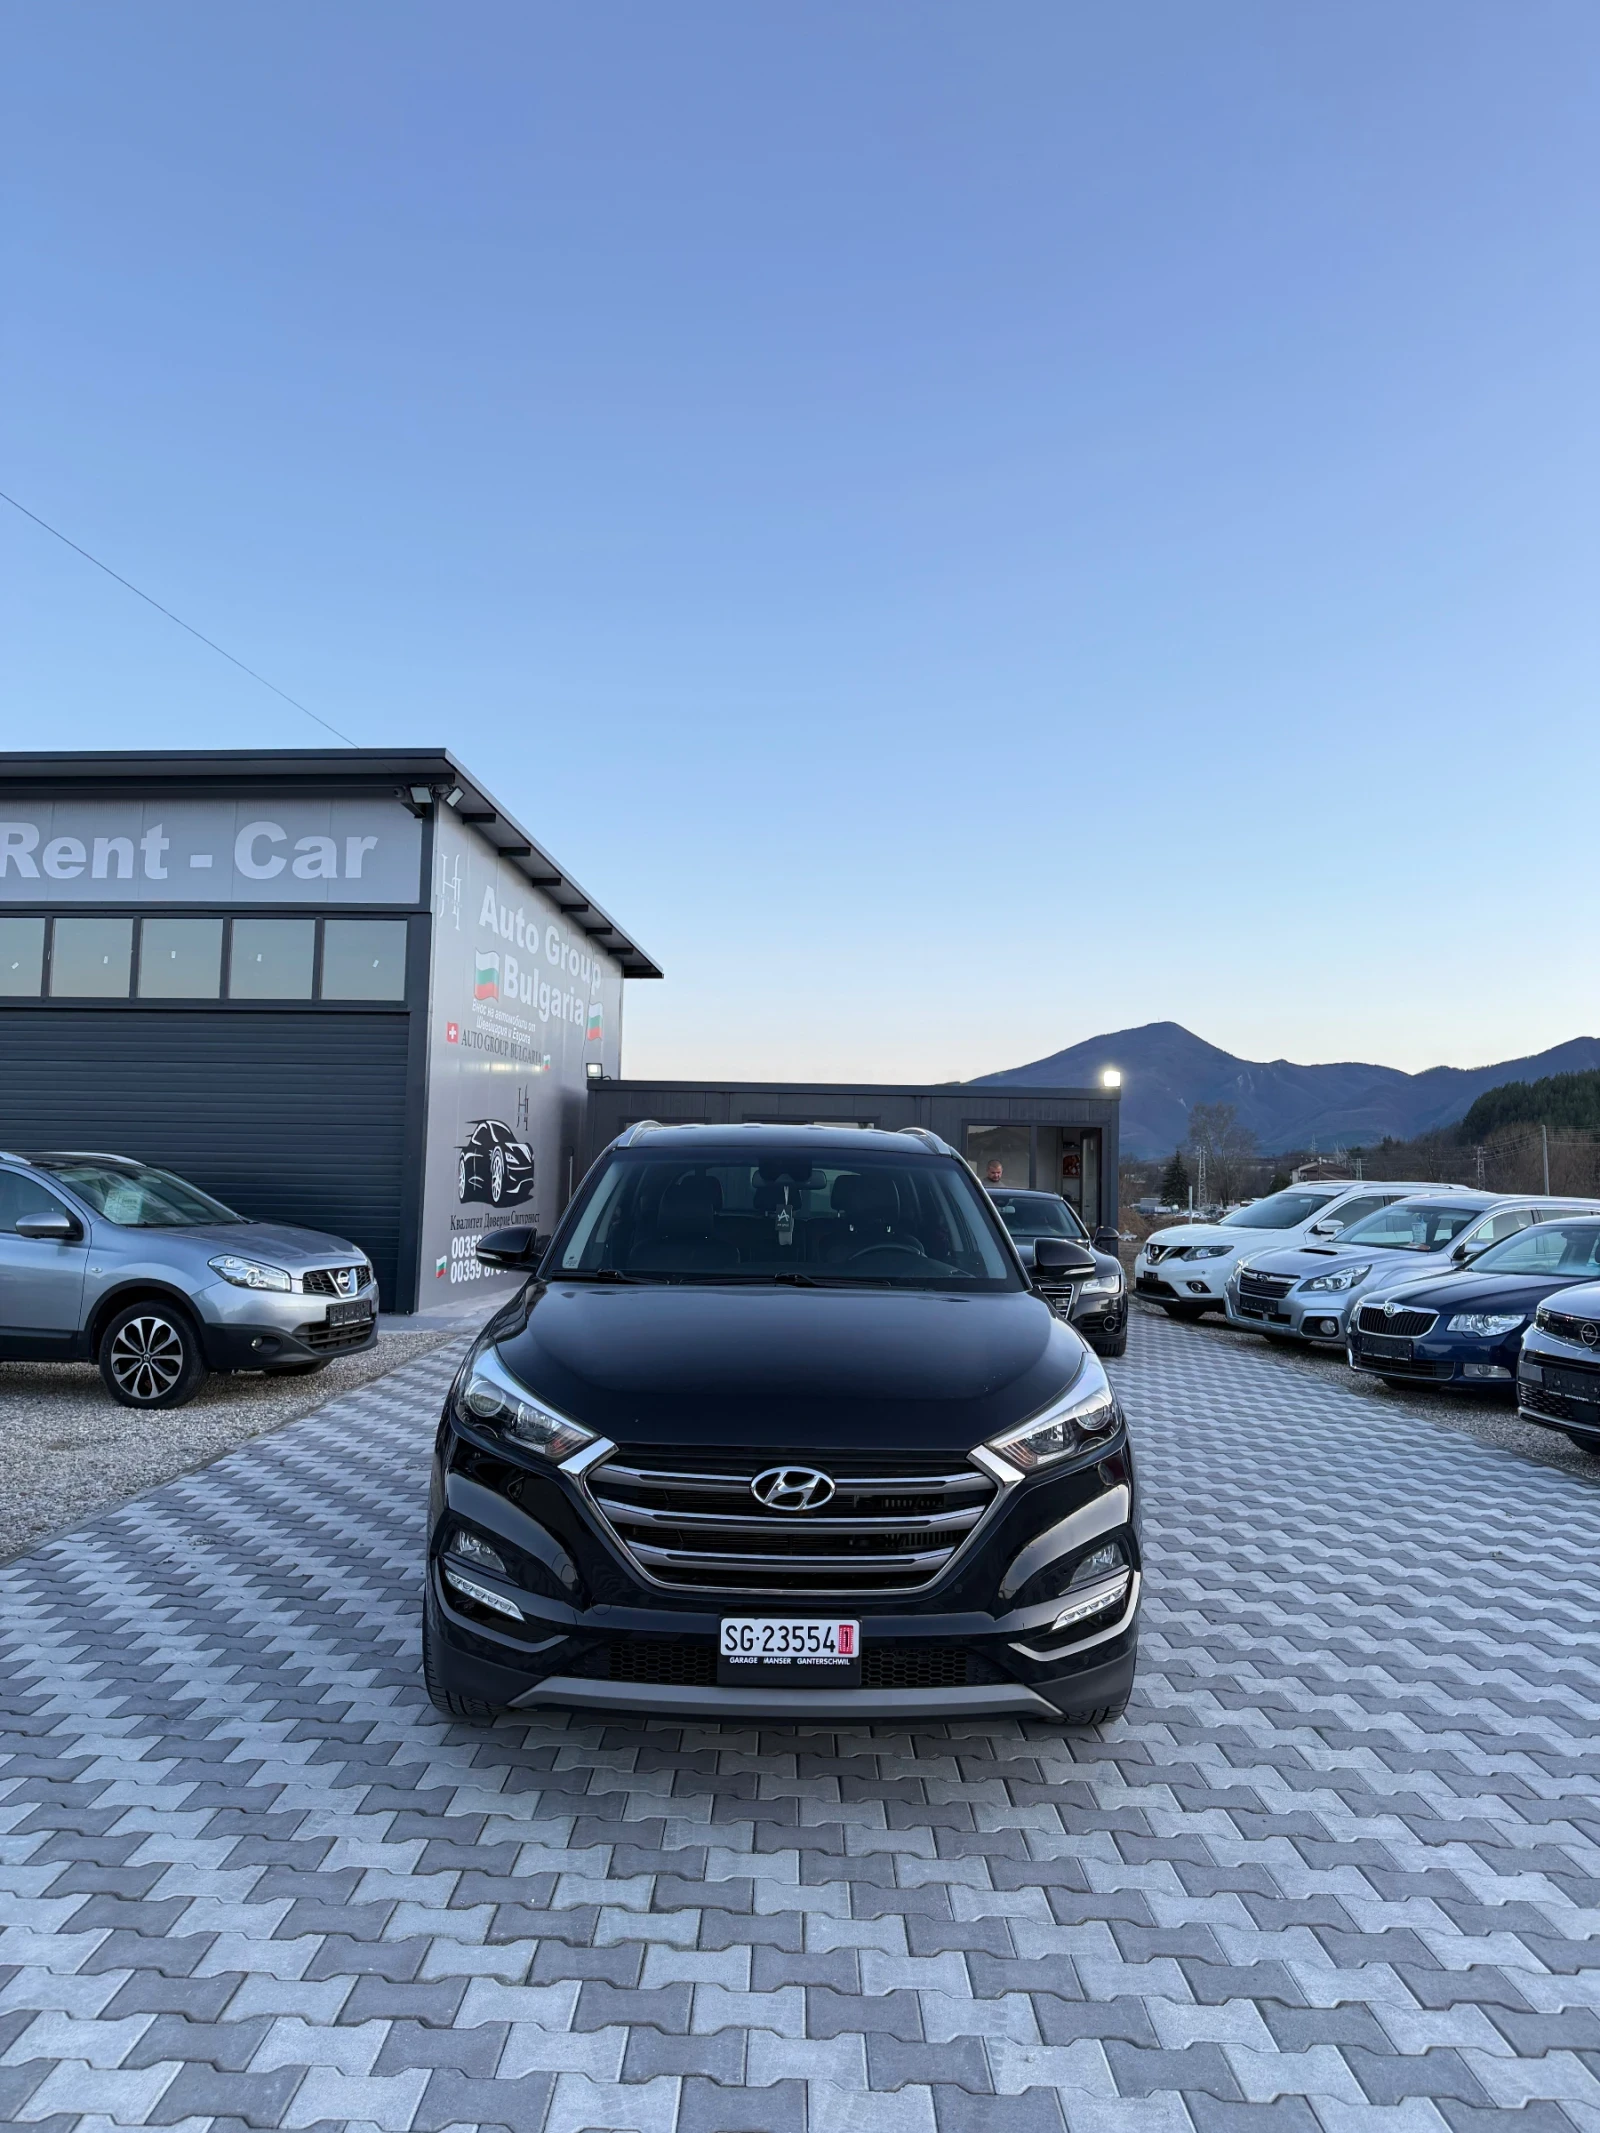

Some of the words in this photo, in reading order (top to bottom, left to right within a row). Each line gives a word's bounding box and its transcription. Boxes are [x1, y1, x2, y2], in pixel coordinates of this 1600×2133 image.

[0, 822, 169, 879] Rent
[234, 821, 378, 879] Car
[478, 885, 539, 955] Auto
[545, 925, 601, 996] Group
[503, 954, 584, 1027] Bulgaria
[461, 1029, 484, 1050] AUTO
[484, 1034, 509, 1057] GROUP
[510, 1042, 544, 1067] BULGARIA
[729, 1656, 758, 1664] GARAGE
[763, 1657, 792, 1665] MANSER
[796, 1657, 850, 1666] GANTERSCHWIL
